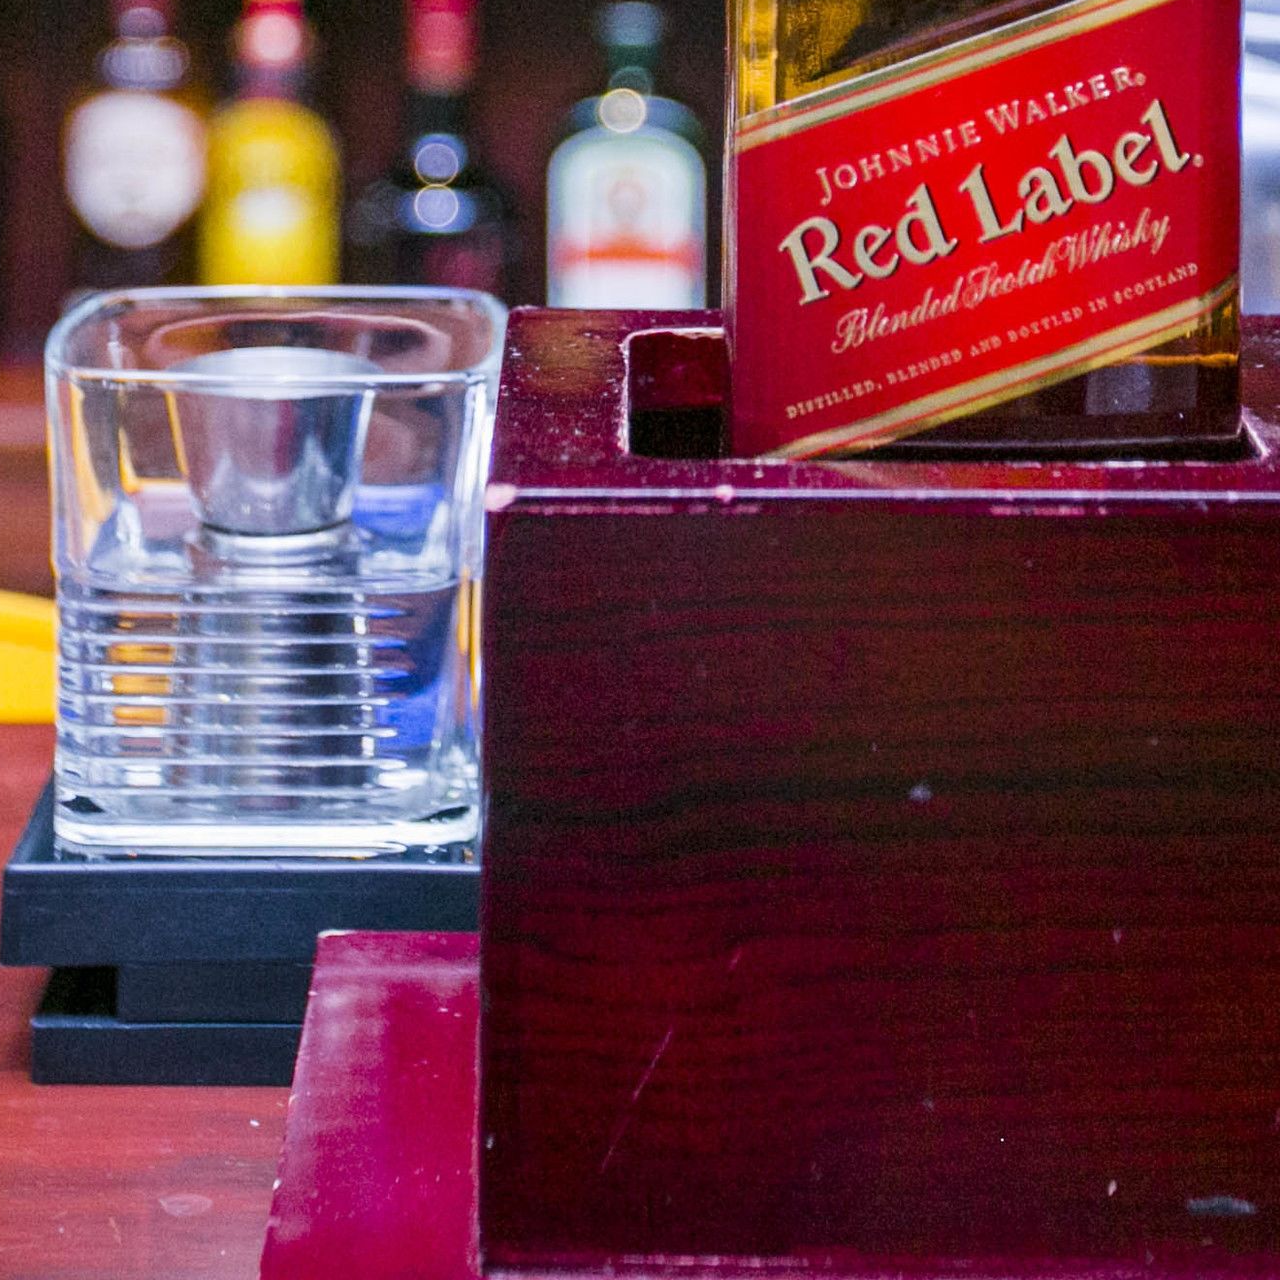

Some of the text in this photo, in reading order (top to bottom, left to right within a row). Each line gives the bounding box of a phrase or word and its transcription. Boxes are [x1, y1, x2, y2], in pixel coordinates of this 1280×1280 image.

[778, 98, 1191, 306] Red Label
[815, 121, 982, 206] JOHNNIE
[784, 262, 1199, 420] DISTILLED, BLENDED AND BOTTLED IN SCOTLAND
[831, 206, 1171, 354] Blended Scotch Whisky
